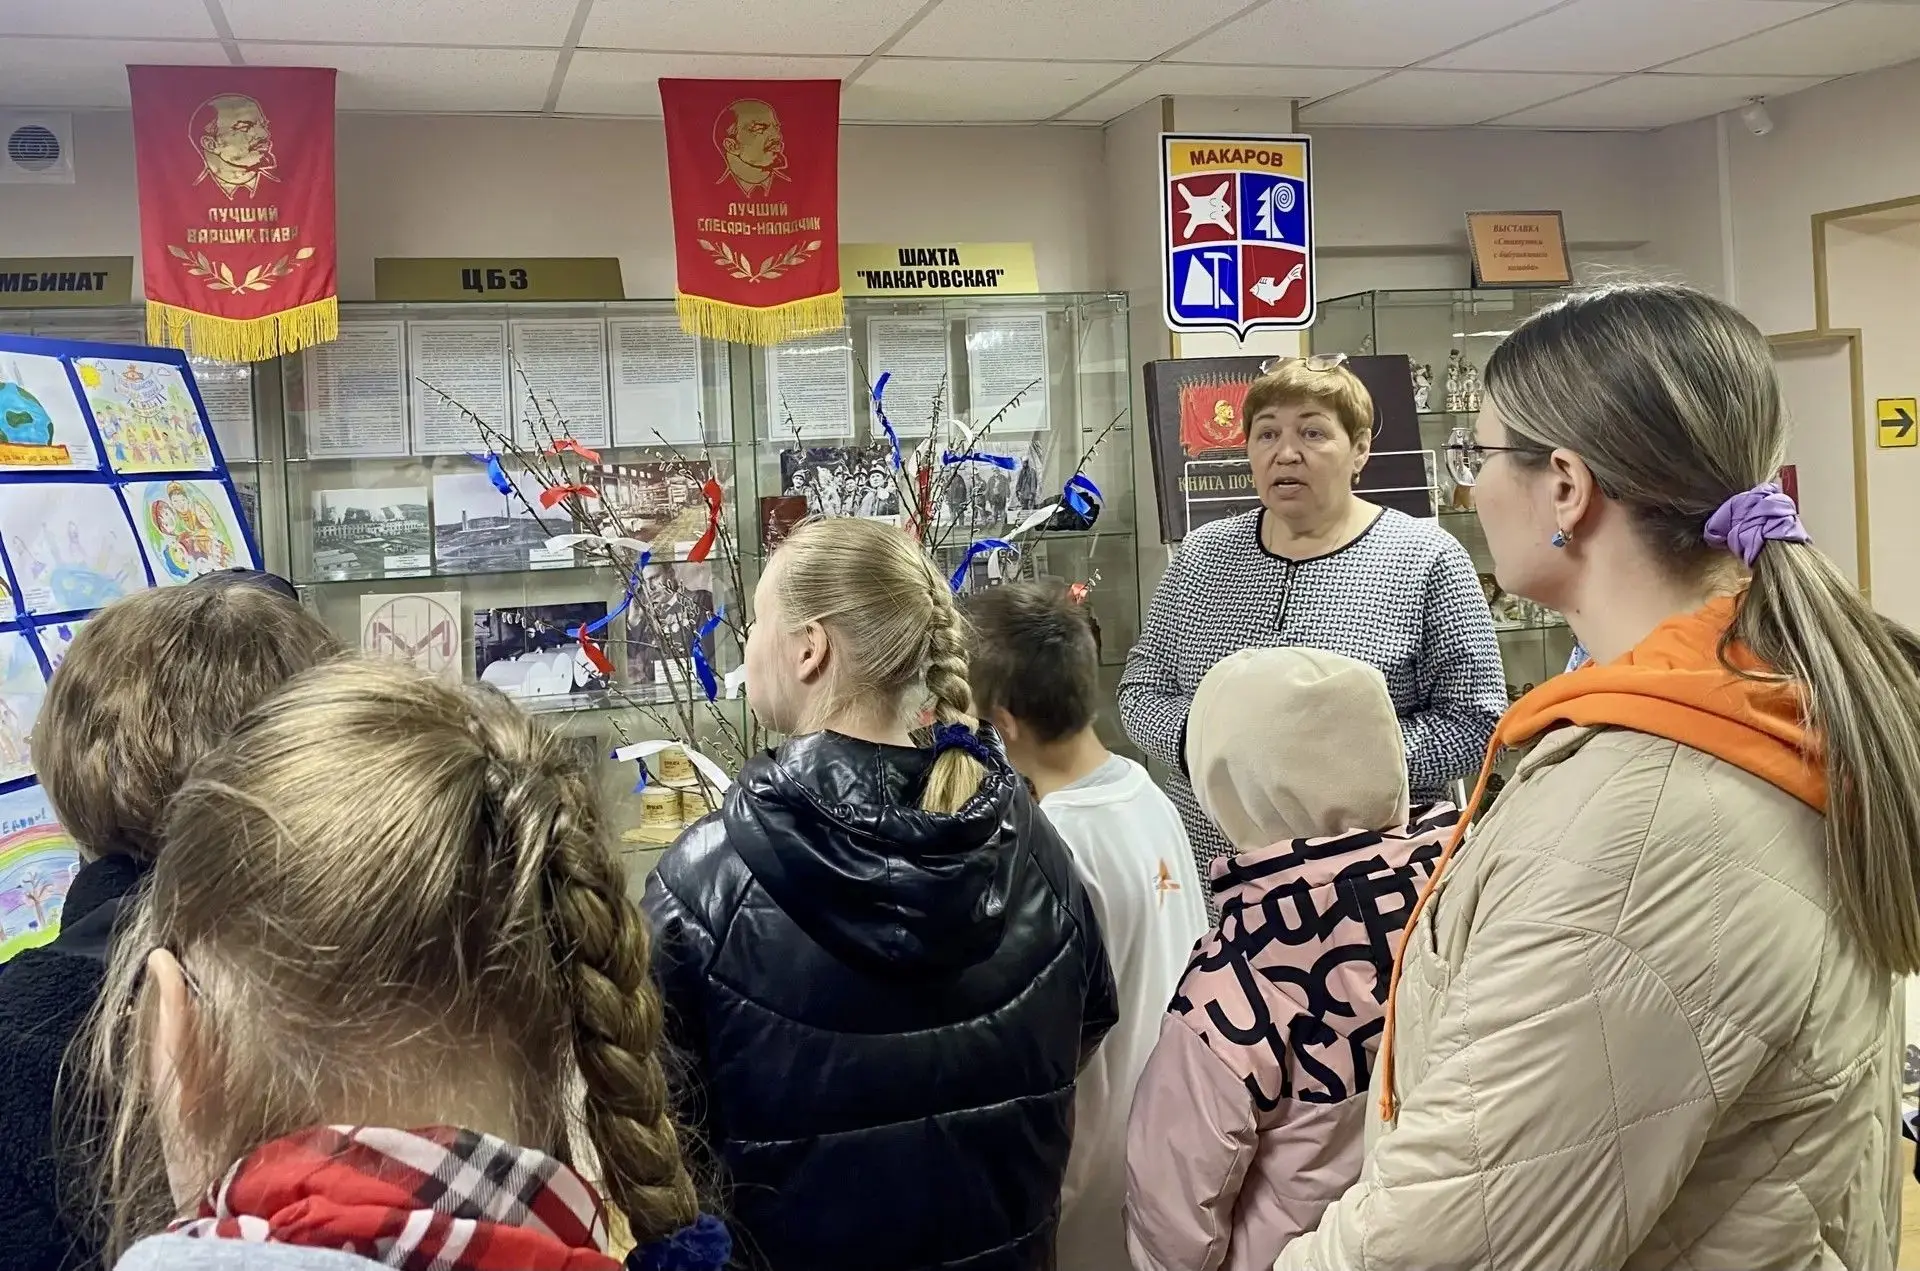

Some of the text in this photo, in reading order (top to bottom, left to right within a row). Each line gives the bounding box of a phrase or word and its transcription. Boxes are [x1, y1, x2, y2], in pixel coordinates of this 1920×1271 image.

[1189, 148, 1283, 167] МАКАРОВ
[208, 204, 278, 223] ЛУЧШИЙ
[728, 200, 788, 216] ЛУЧШИЙ
[697, 216, 821, 235] СЛЕСАРЬ-НАЛАДЧИК
[1493, 224, 1539, 233] ВЫСТАВКА
[898, 248, 960, 266] ШАХТА
[0, 272, 108, 292] МБИНАТ
[462, 268, 528, 293] ЦБЗ
[857, 269, 1004, 288] "МАКАРОВСКАЯ"
[1178, 473, 1256, 492] КНИГА ПОЧ
